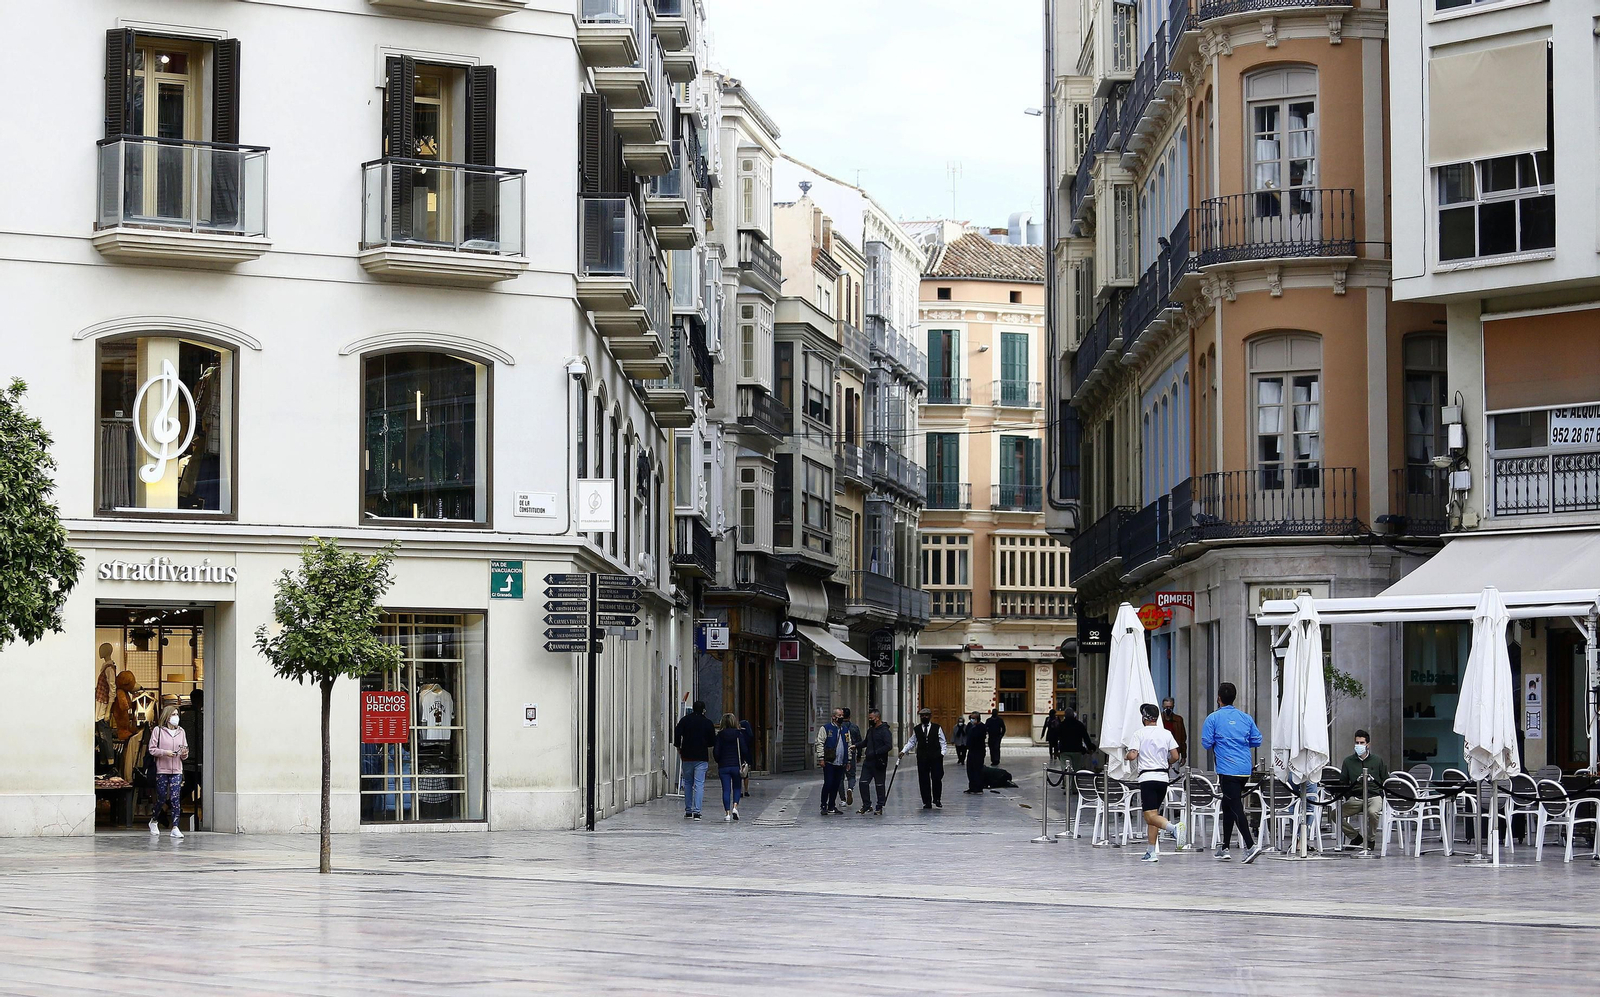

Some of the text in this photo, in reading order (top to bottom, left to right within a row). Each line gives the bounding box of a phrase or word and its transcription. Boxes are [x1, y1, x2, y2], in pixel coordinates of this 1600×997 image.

[1555, 408, 1568, 418] SE
[1552, 427, 1569, 443] 952
[1571, 427, 1582, 443] 28
[1584, 427, 1594, 443] 67
[98, 556, 238, 583] stradivarius
[1158, 594, 1192, 607] CAMPER
[366, 694, 406, 703] ÚLTIMOS
